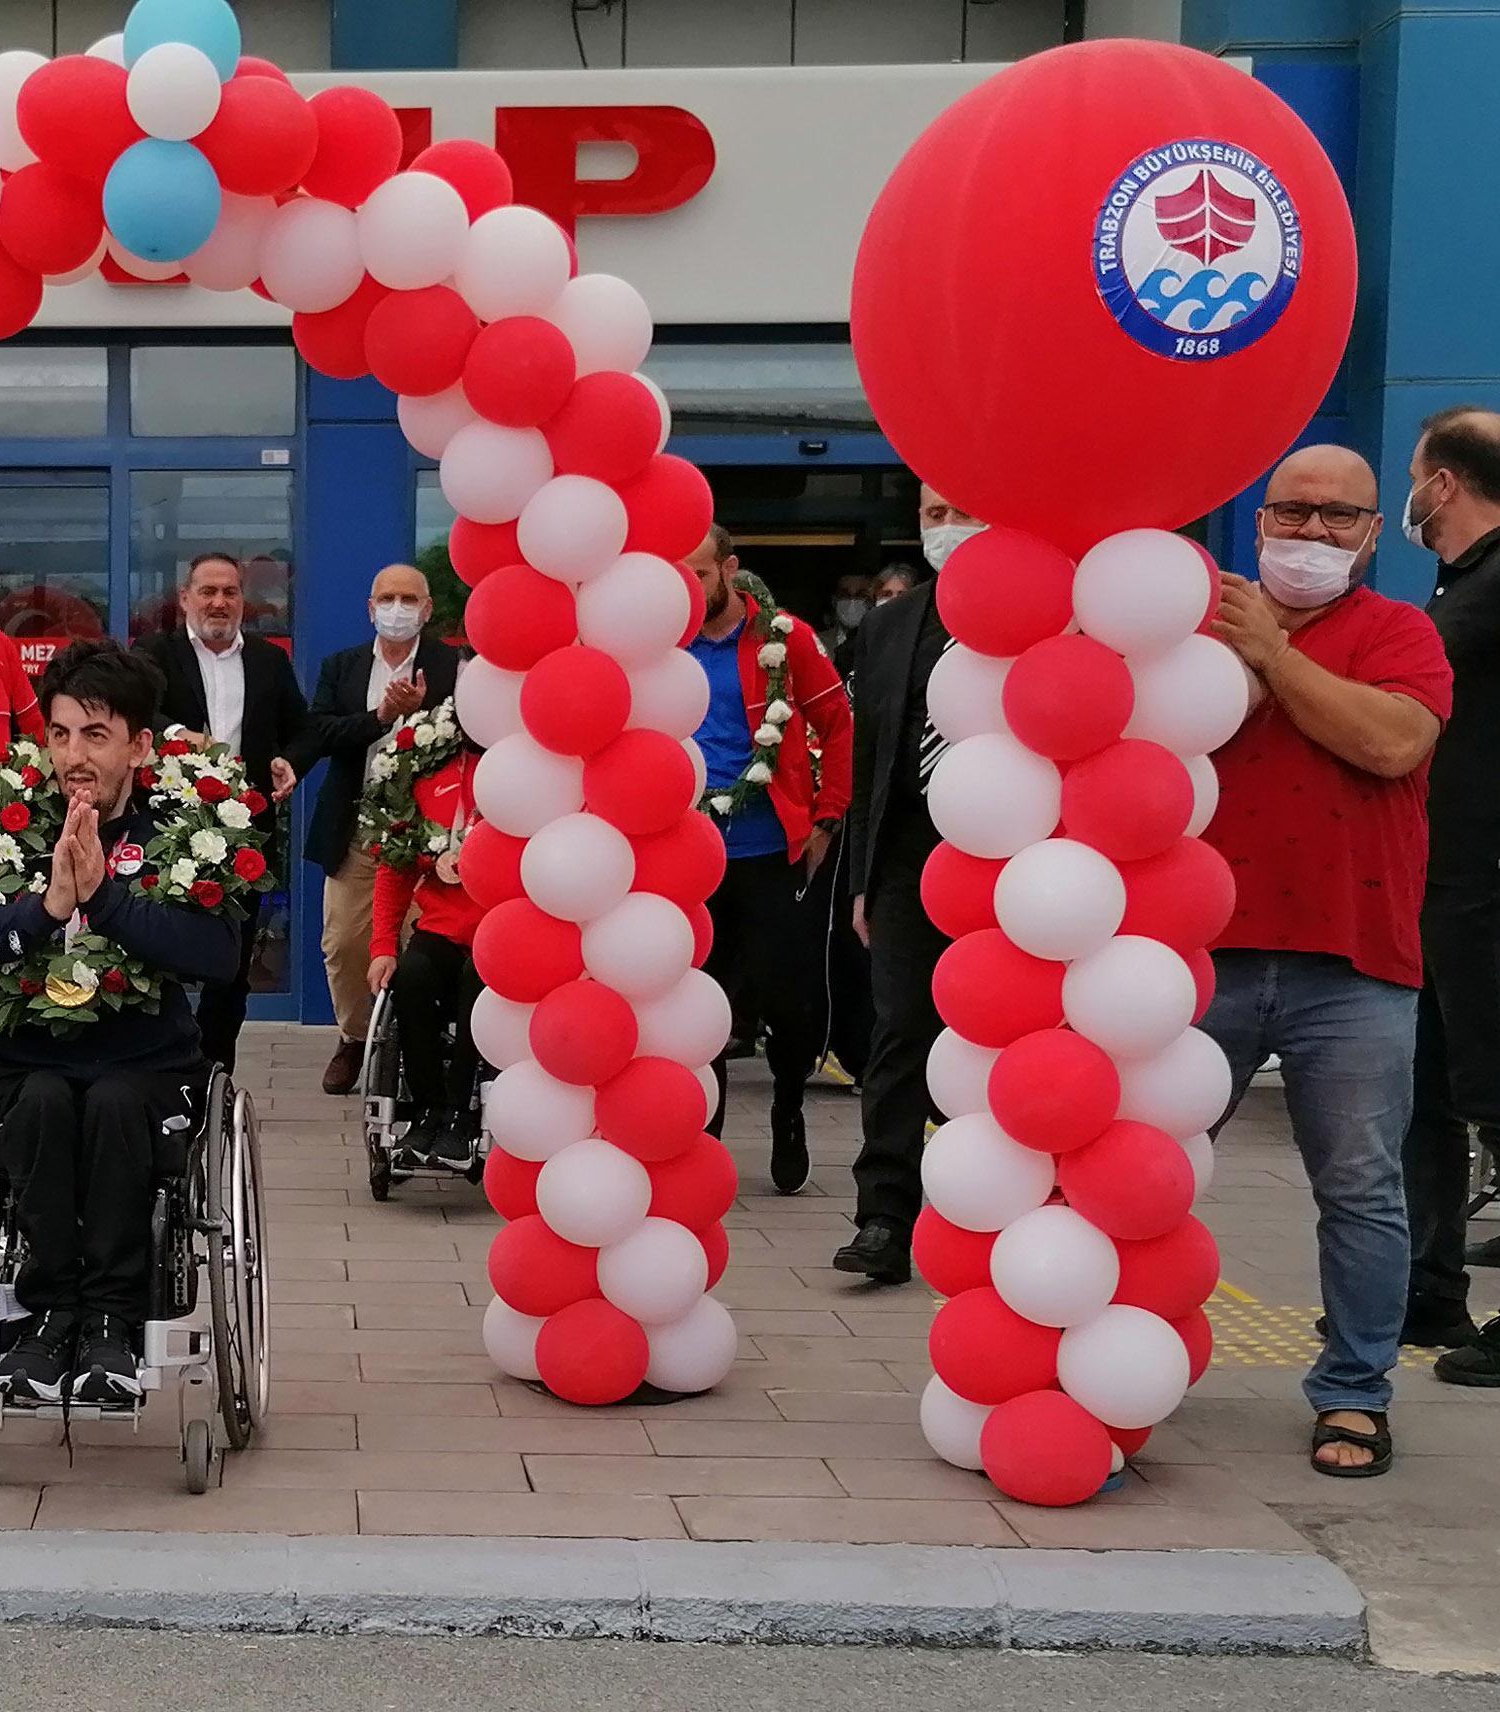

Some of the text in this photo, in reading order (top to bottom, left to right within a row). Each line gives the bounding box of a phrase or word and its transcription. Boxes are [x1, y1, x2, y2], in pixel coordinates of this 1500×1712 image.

[1099, 177, 1140, 276] TRABZON
[1132, 143, 1256, 181] BÜYÜKŞEHİR
[1175, 337, 1220, 355] 1868
